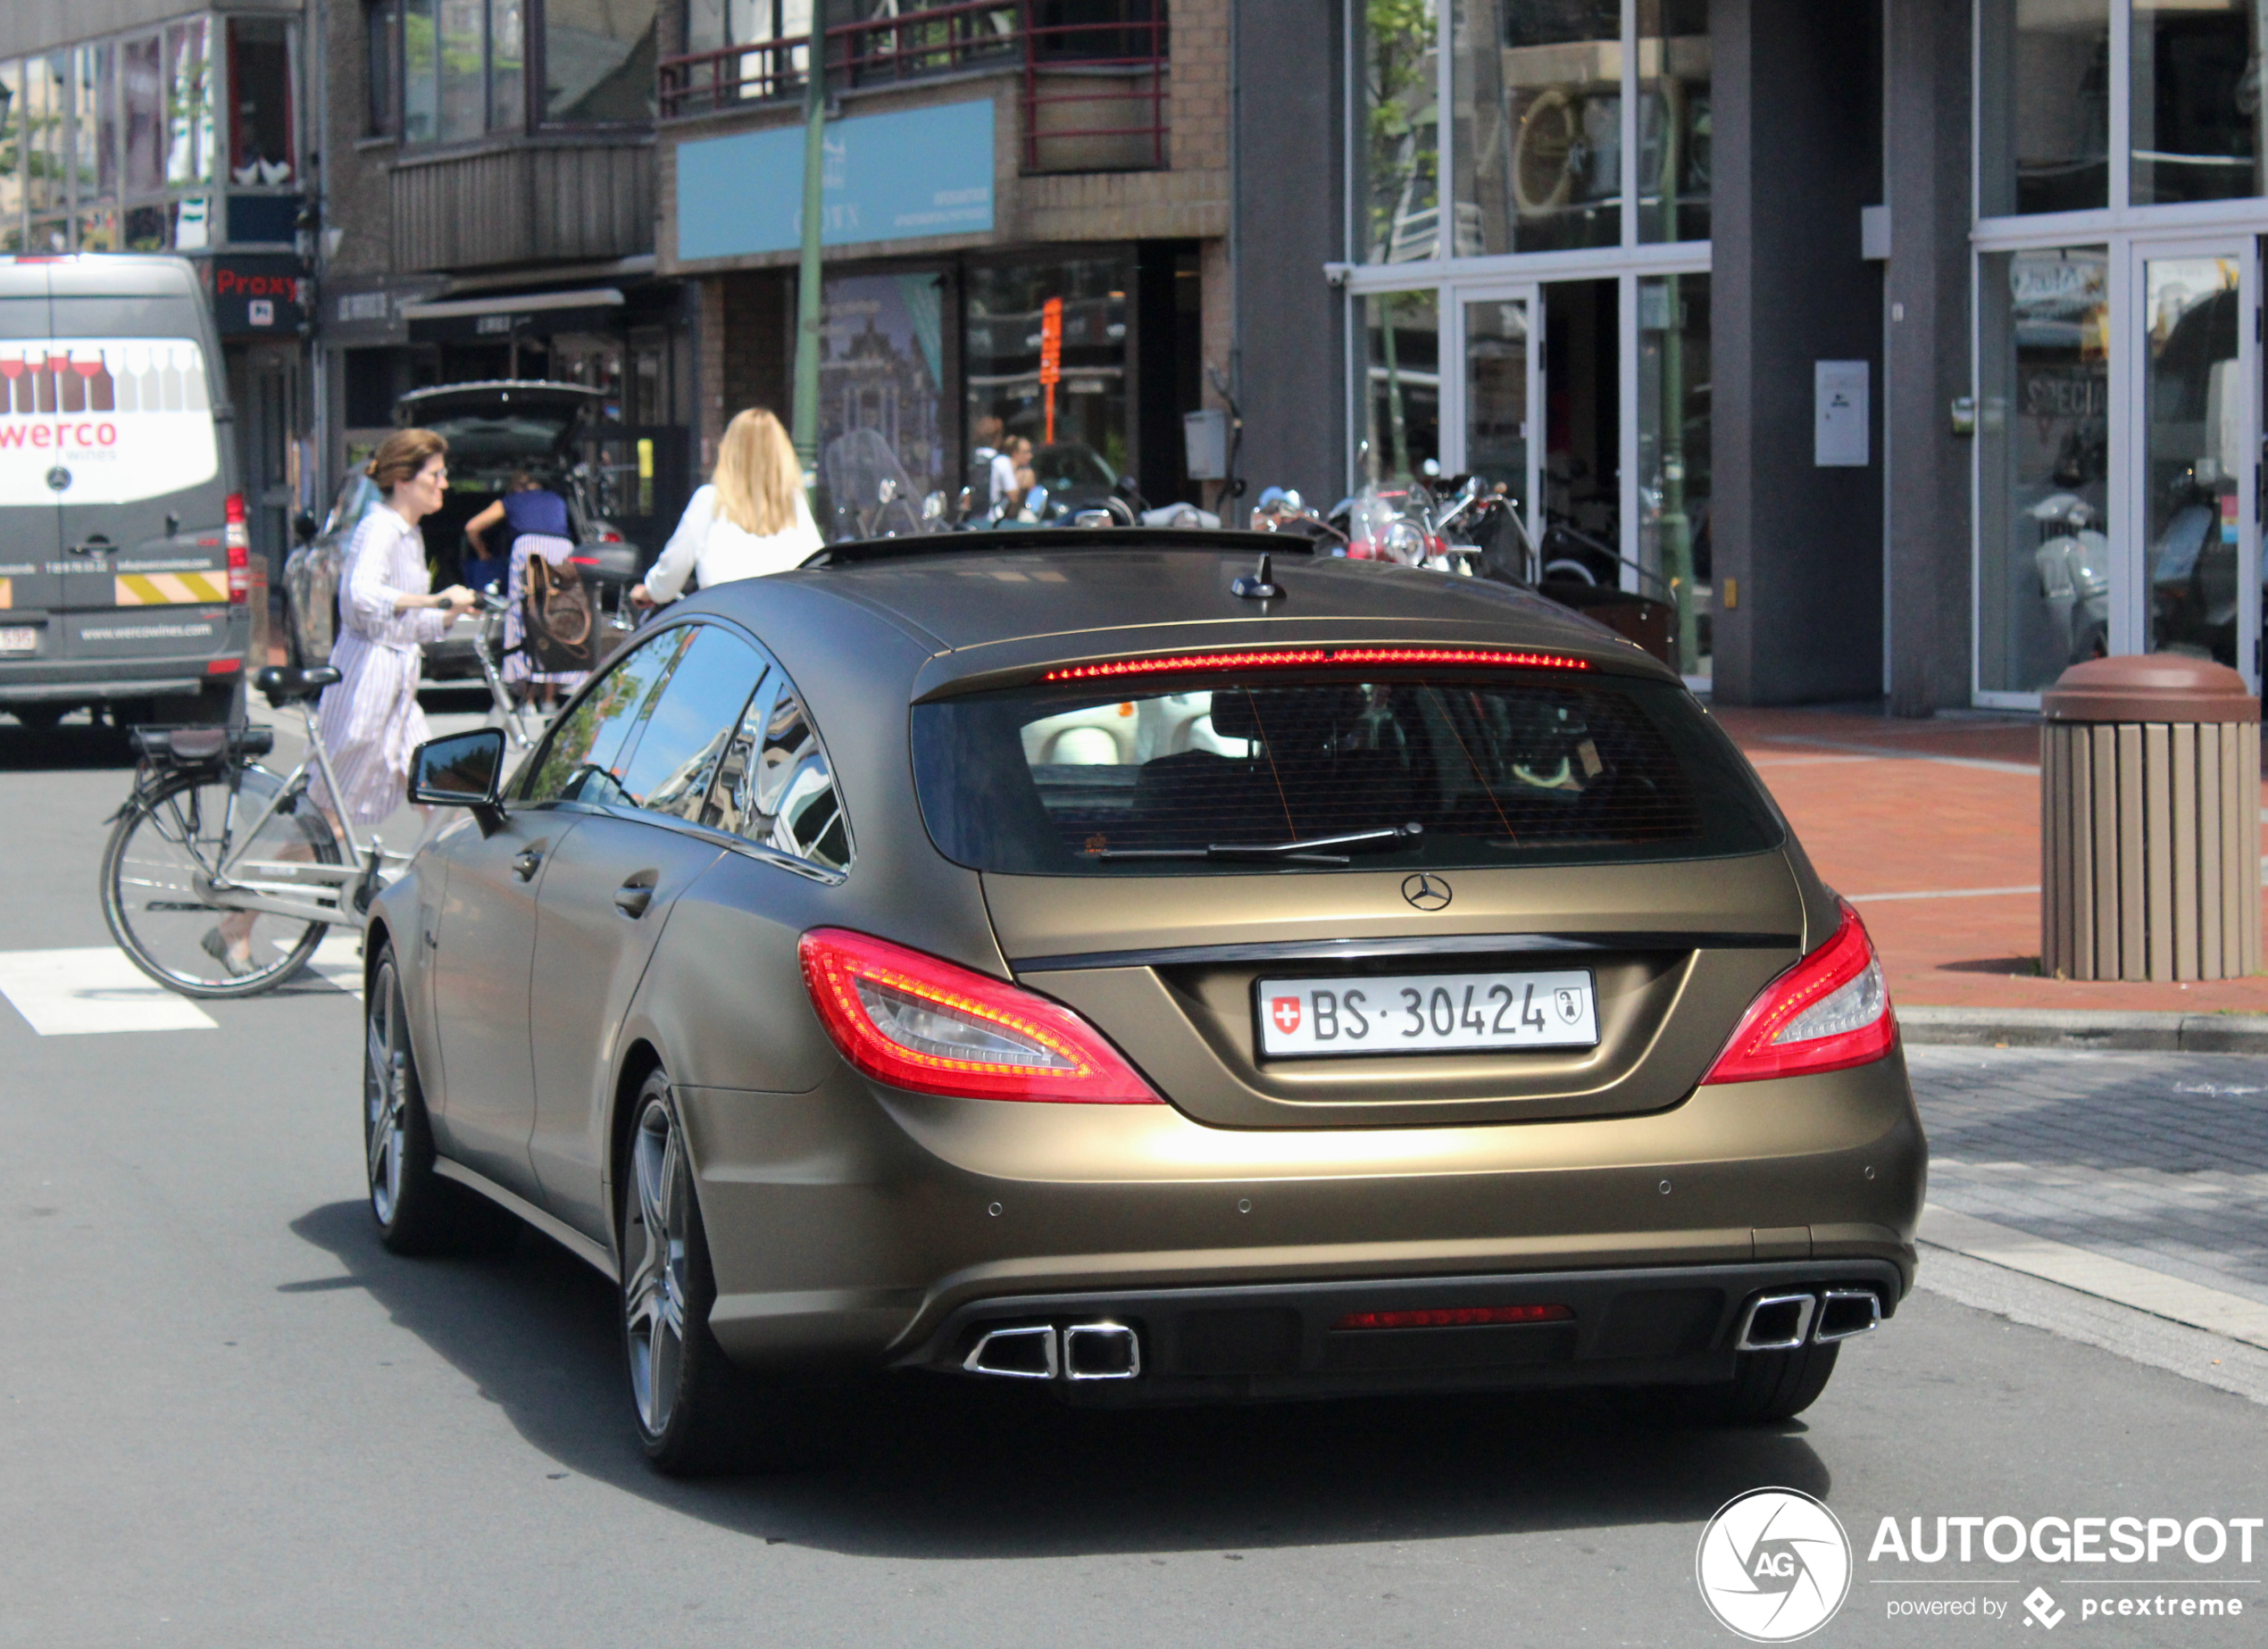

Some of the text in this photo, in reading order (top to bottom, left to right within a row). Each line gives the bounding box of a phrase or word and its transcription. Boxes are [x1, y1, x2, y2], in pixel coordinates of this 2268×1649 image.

[217, 270, 296, 302] Proxy
[0, 423, 116, 447] werco
[66, 449, 116, 461] wines
[80, 624, 213, 640] www.wercowines.com
